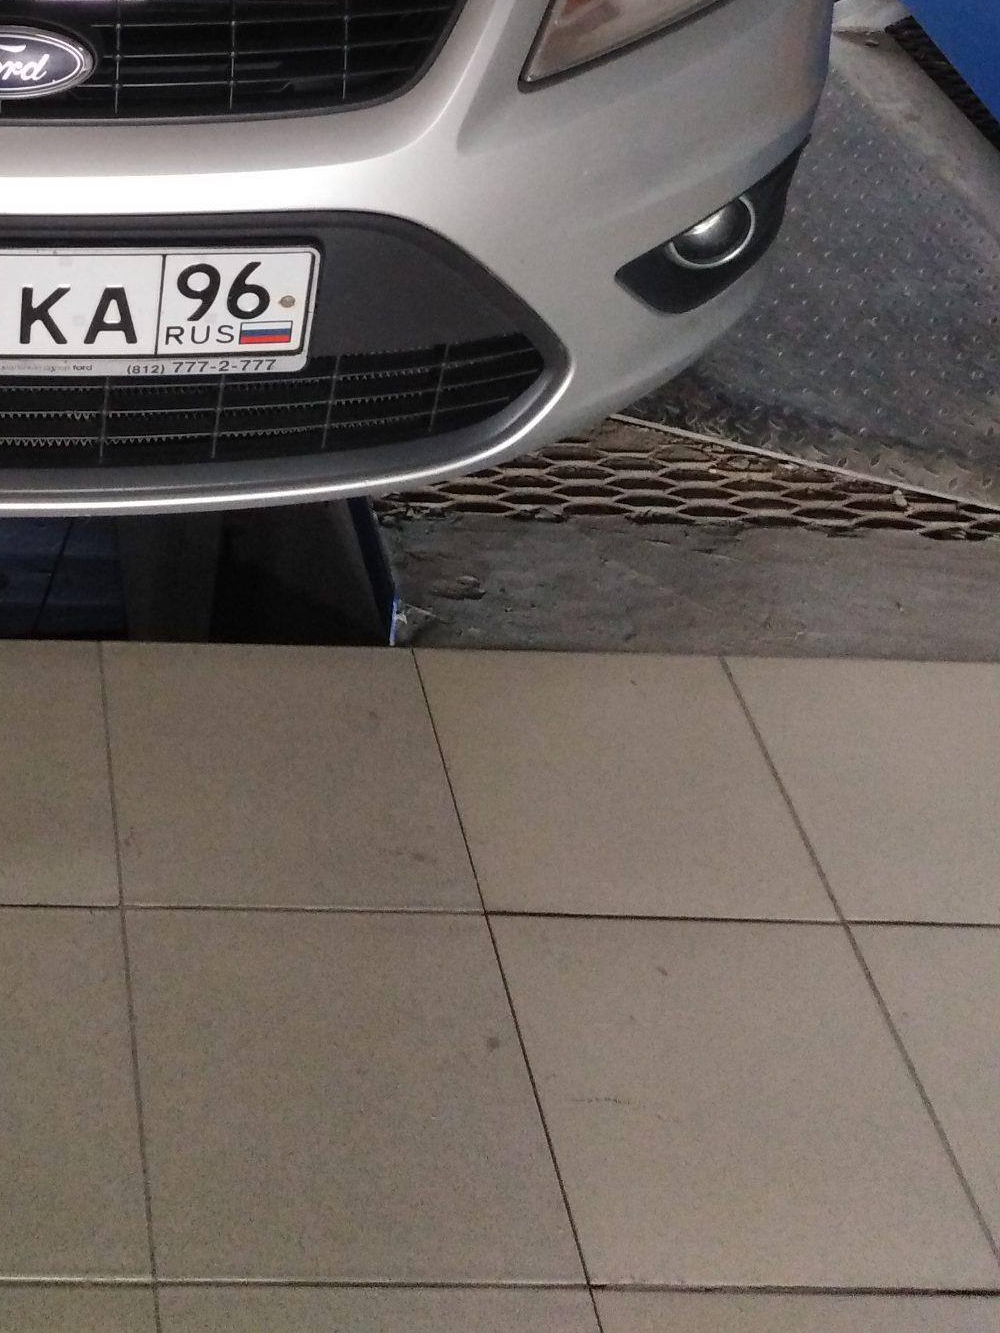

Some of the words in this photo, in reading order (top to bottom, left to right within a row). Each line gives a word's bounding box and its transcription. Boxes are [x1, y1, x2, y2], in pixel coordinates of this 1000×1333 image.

[176, 262, 271, 320] 96
[165, 325, 234, 345] RUS
[127, 365, 165, 374] (812)
[172, 359, 277, 373] 777-2-777
